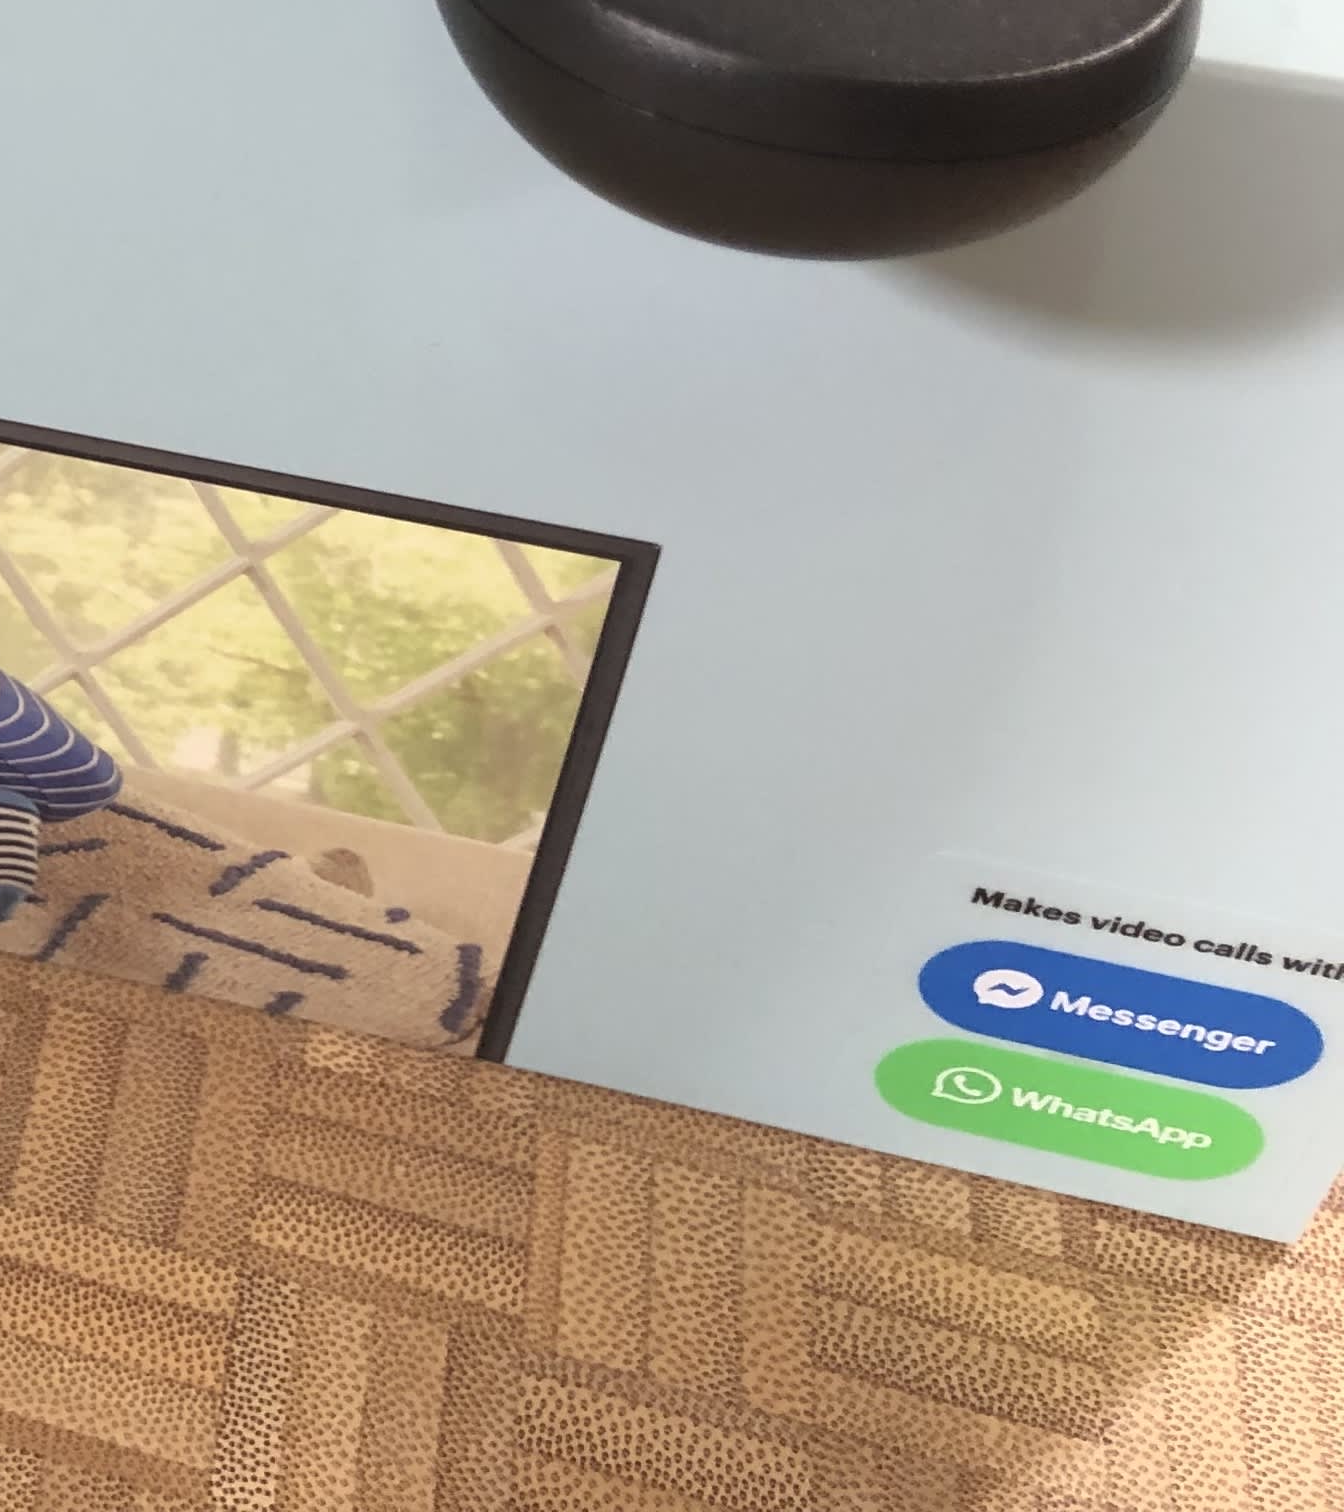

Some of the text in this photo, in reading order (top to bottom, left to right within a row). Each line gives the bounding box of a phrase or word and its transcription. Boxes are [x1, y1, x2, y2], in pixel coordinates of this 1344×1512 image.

[971, 887, 1081, 925] Makes
[1091, 916, 1186, 947] video
[1193, 937, 1273, 966] calls
[1050, 991, 1276, 1054] Messenger
[1012, 1087, 1212, 1149] WhatsApp
